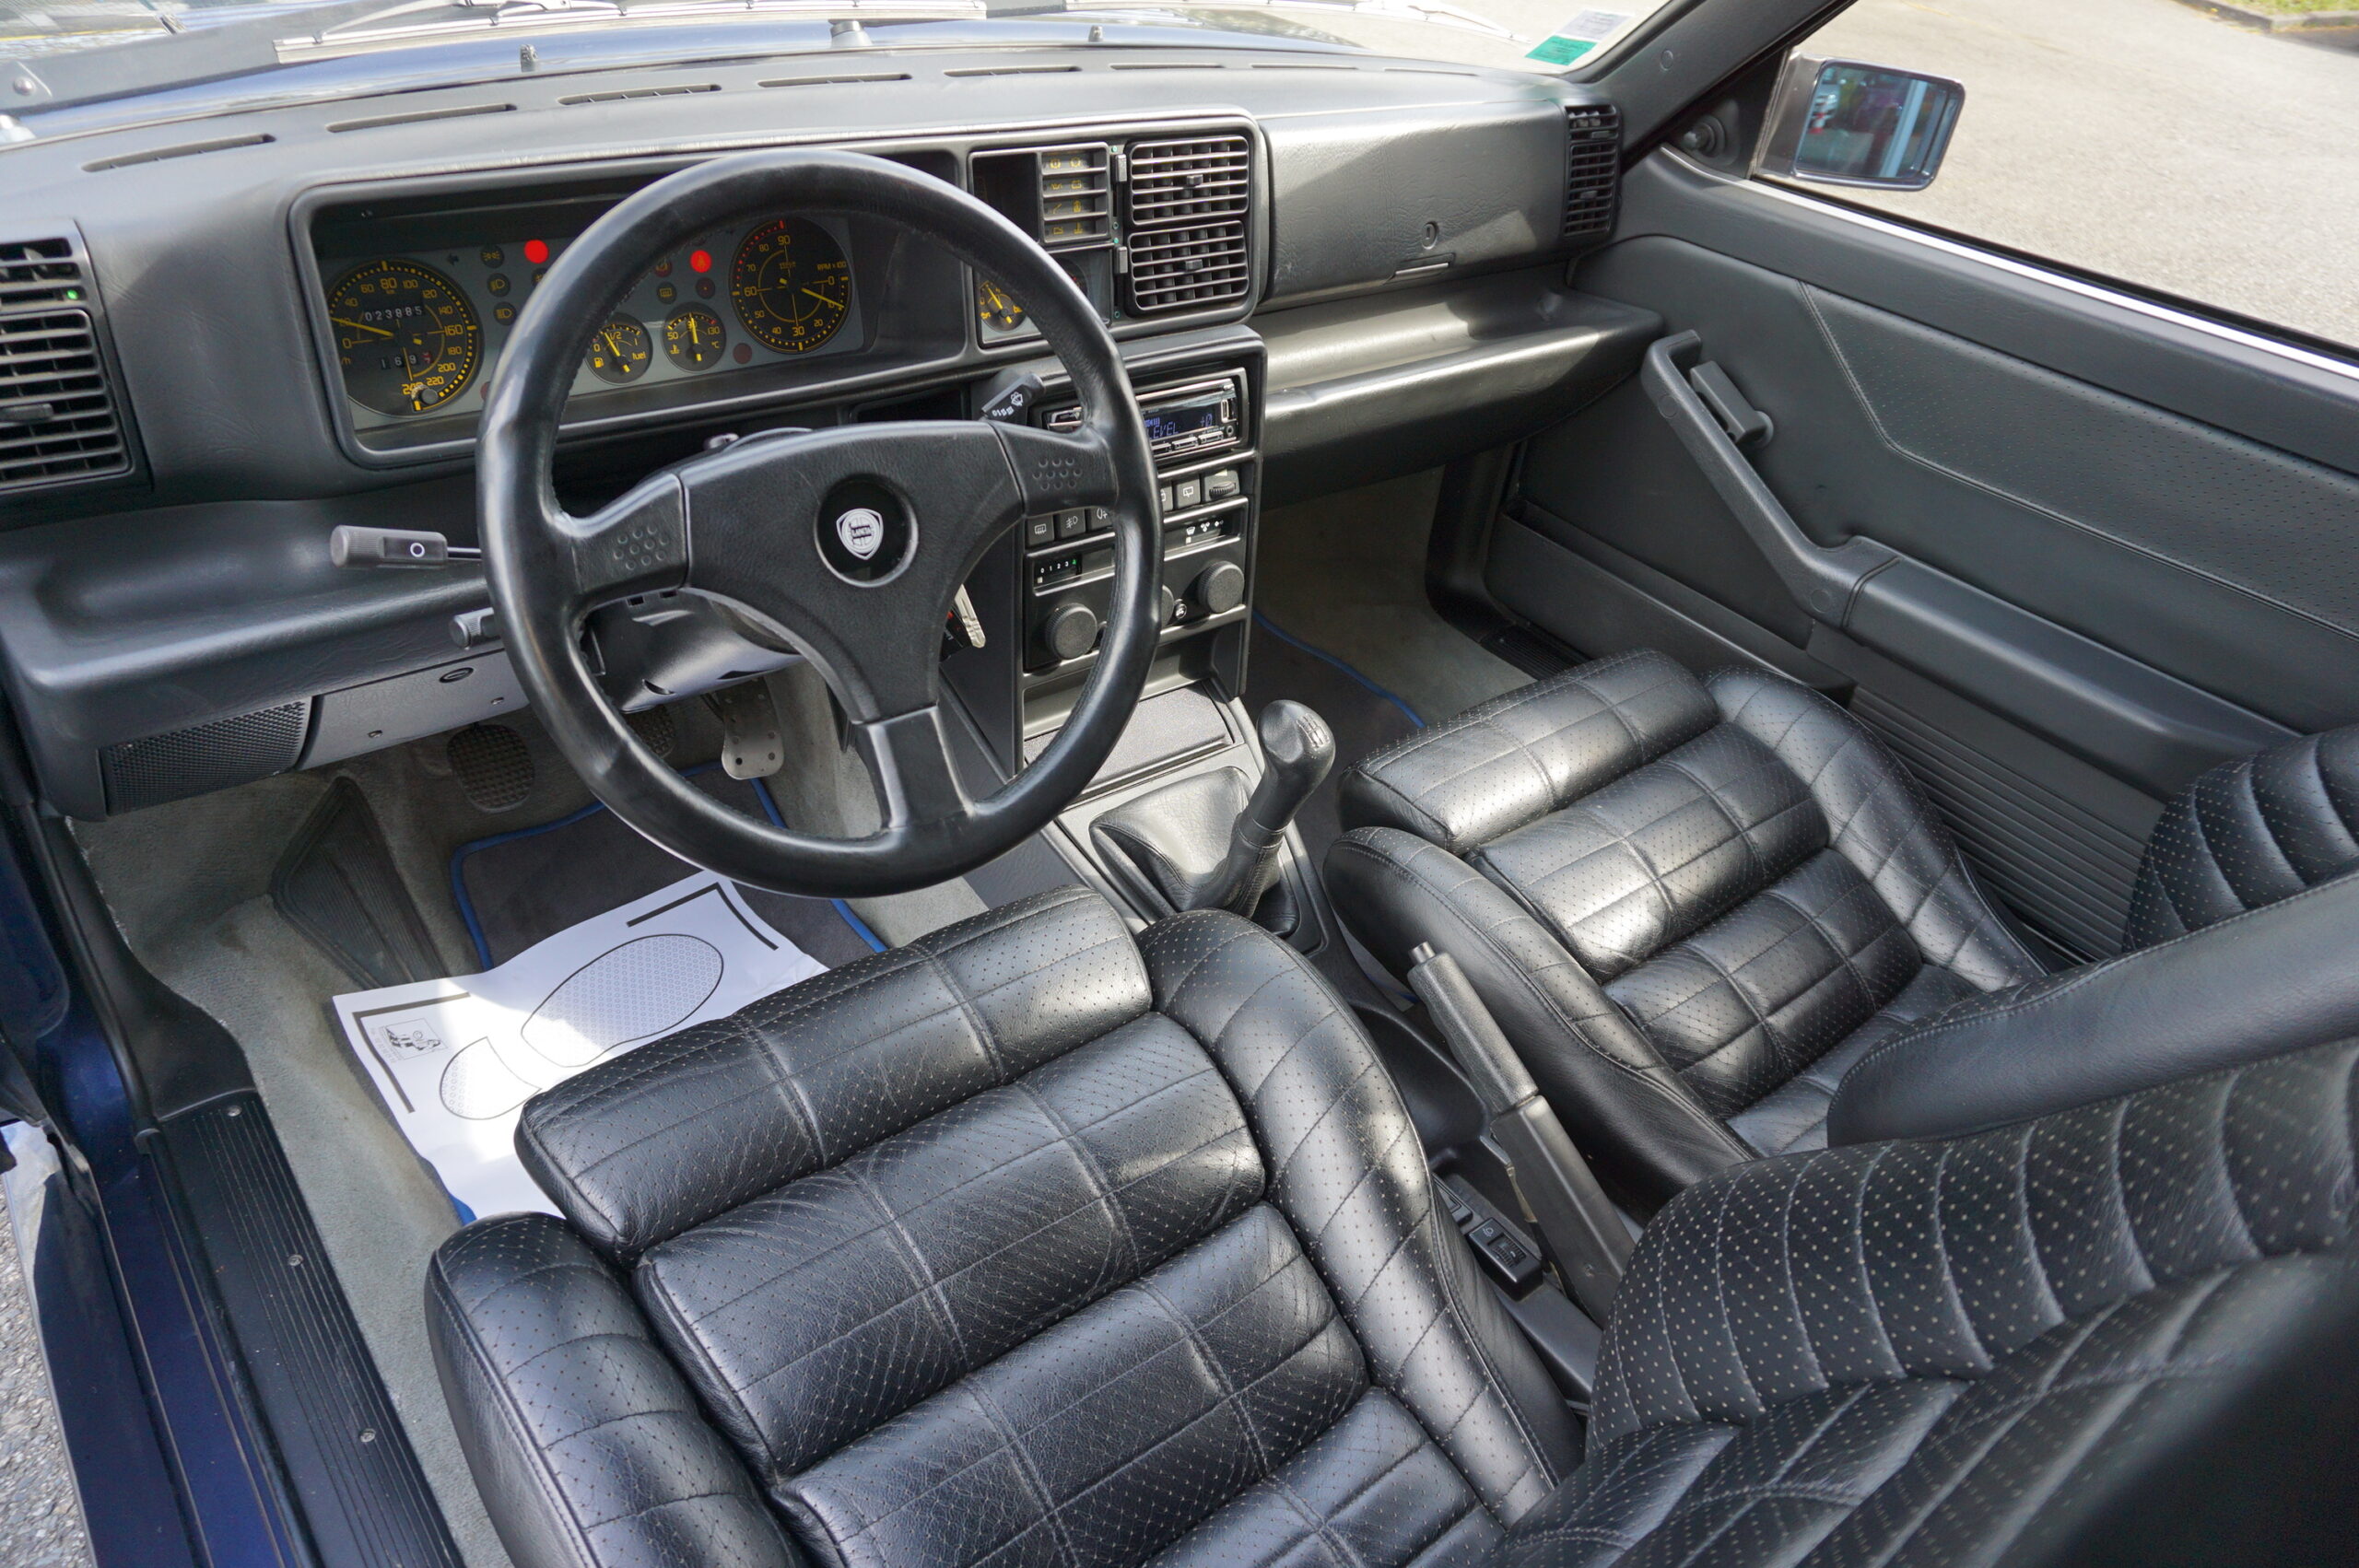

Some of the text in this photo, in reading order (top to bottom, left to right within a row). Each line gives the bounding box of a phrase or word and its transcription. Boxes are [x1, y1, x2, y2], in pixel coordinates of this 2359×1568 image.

[778, 235, 791, 245] 90
[758, 243, 769, 252] 80
[746, 263, 756, 272] 70
[381, 277, 397, 289] 80
[403, 279, 418, 288] 100
[828, 275, 835, 285] 0
[360, 284, 374, 293] 60
[744, 286, 757, 297] 60
[754, 310, 765, 318] 50
[444, 324, 464, 335] 160
[772, 326, 781, 334] 40
[792, 326, 804, 336] 30
[667, 332, 679, 341] 50
[342, 337, 352, 348] 0
[448, 346, 462, 356] 180
[593, 344, 601, 352] 0
[438, 362, 456, 372] 200
[426, 376, 444, 386] 220
